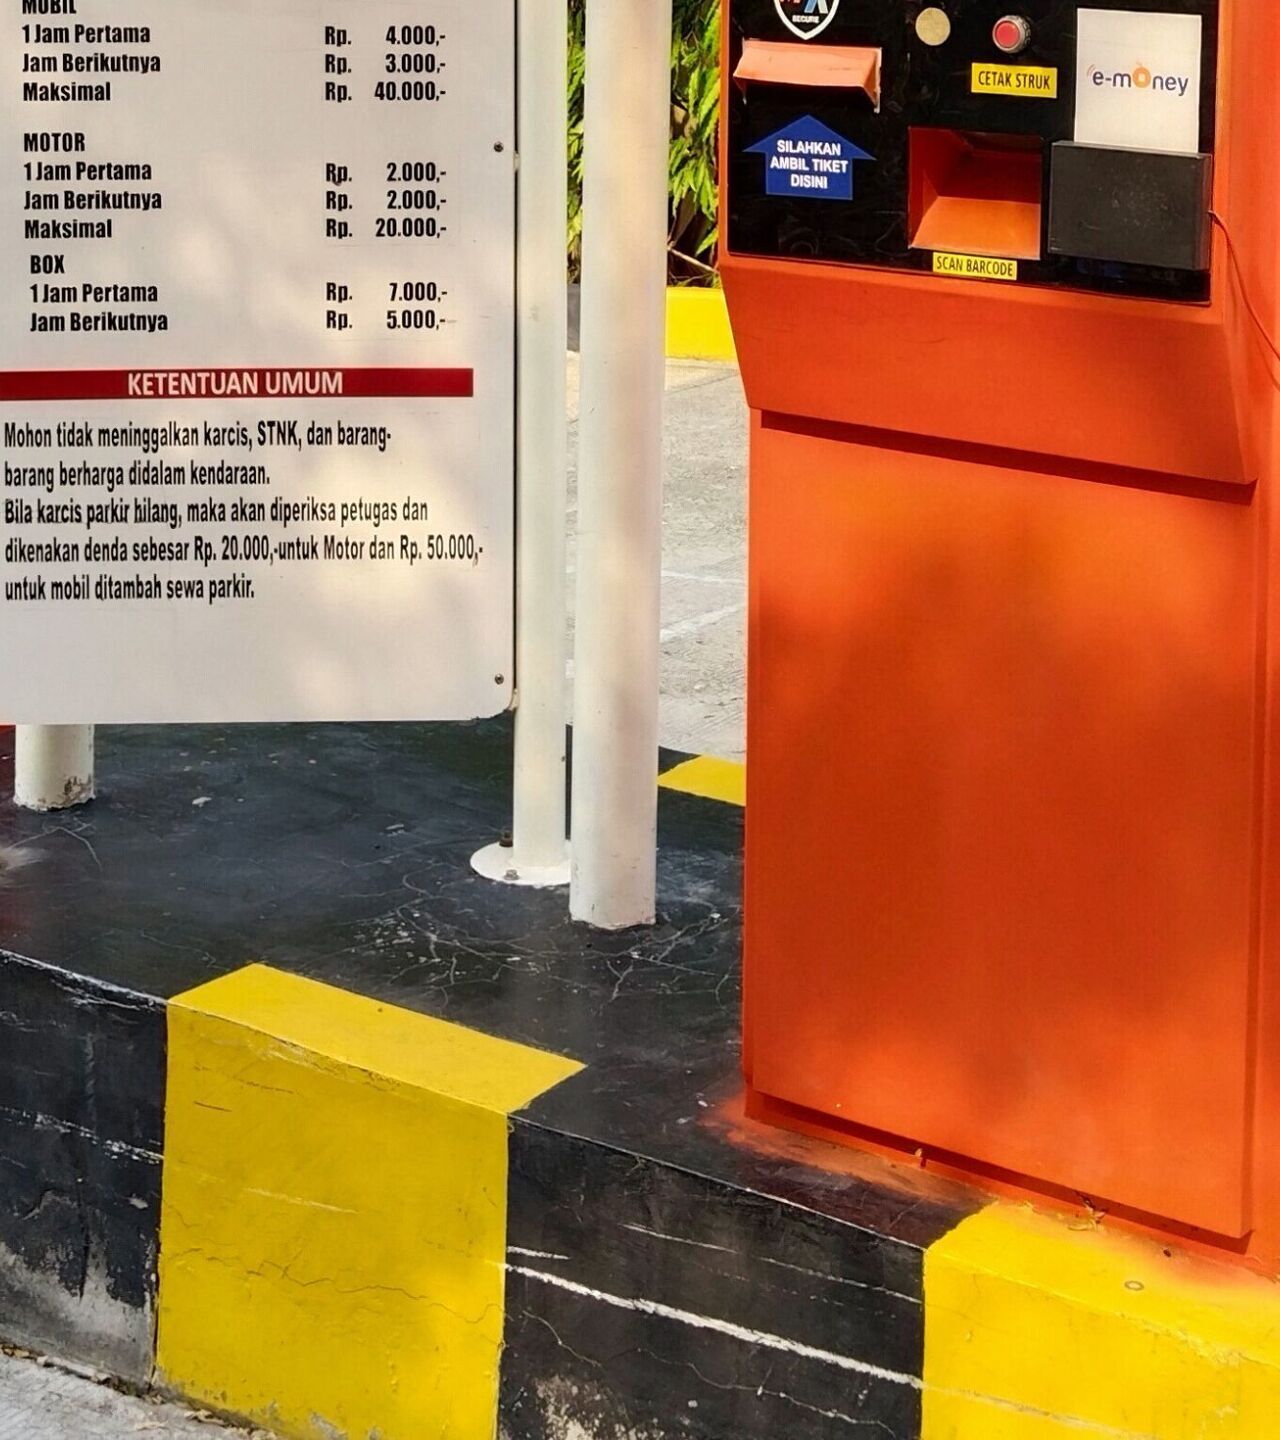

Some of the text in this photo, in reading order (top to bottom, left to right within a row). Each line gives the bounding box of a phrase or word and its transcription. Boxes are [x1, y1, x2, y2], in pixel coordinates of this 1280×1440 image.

[22, 24, 150, 43] 1 Jam Pertama
[325, 26, 445, 47] Rp. 4.000,-
[23, 53, 160, 73] Jam Berikutnya
[326, 54, 445, 74] Rp. 3.000,-
[979, 71, 1050, 89] CETAK STRUK
[24, 82, 110, 101] Maksimal
[326, 81, 445, 102] Rp. 40.000,-
[24, 133, 85, 152] MOTOR
[777, 140, 840, 155] SILAHKAN
[24, 162, 151, 180] 1 Jam Pertama
[326, 162, 446, 185] Rp. 2.000,-
[770, 156, 848, 173] AMBIL TIKET
[791, 174, 827, 188] DISINI
[24, 190, 161, 210] Jam Berikutnya
[327, 190, 446, 211] Rp. 2.000,-
[25, 219, 111, 238] Maksimal
[327, 218, 446, 239] Rp. 20.000,-
[31, 255, 64, 274] BOX
[936, 256, 1013, 278] SCAN BARCODE
[30, 284, 157, 303] 1 Jam Pertama
[327, 282, 447, 303] Rp. 7.000,-
[31, 312, 167, 332] Jam Berikutnya
[327, 310, 352, 330] Rp.
[129, 372, 342, 395] KETENTUAN UMUM
[5, 421, 390, 453] Mohon tidak meninggalkan karcis, STNK, dan barang-
[5, 460, 269, 493] barang berharga didalam kendaraan.
[5, 496, 427, 529] Bila karcis parkir hilang, maka akan diperiksa petugas dan
[6, 537, 79, 562] dikenakan
[85, 536, 127, 561] denda
[133, 537, 189, 561] sebesar
[195, 536, 216, 567] Rp.
[324, 535, 364, 559] Motor
[370, 535, 394, 559] dan
[401, 535, 421, 565] Rp.
[6, 573, 254, 604] untuk mobil ditambah sewa parkir.
